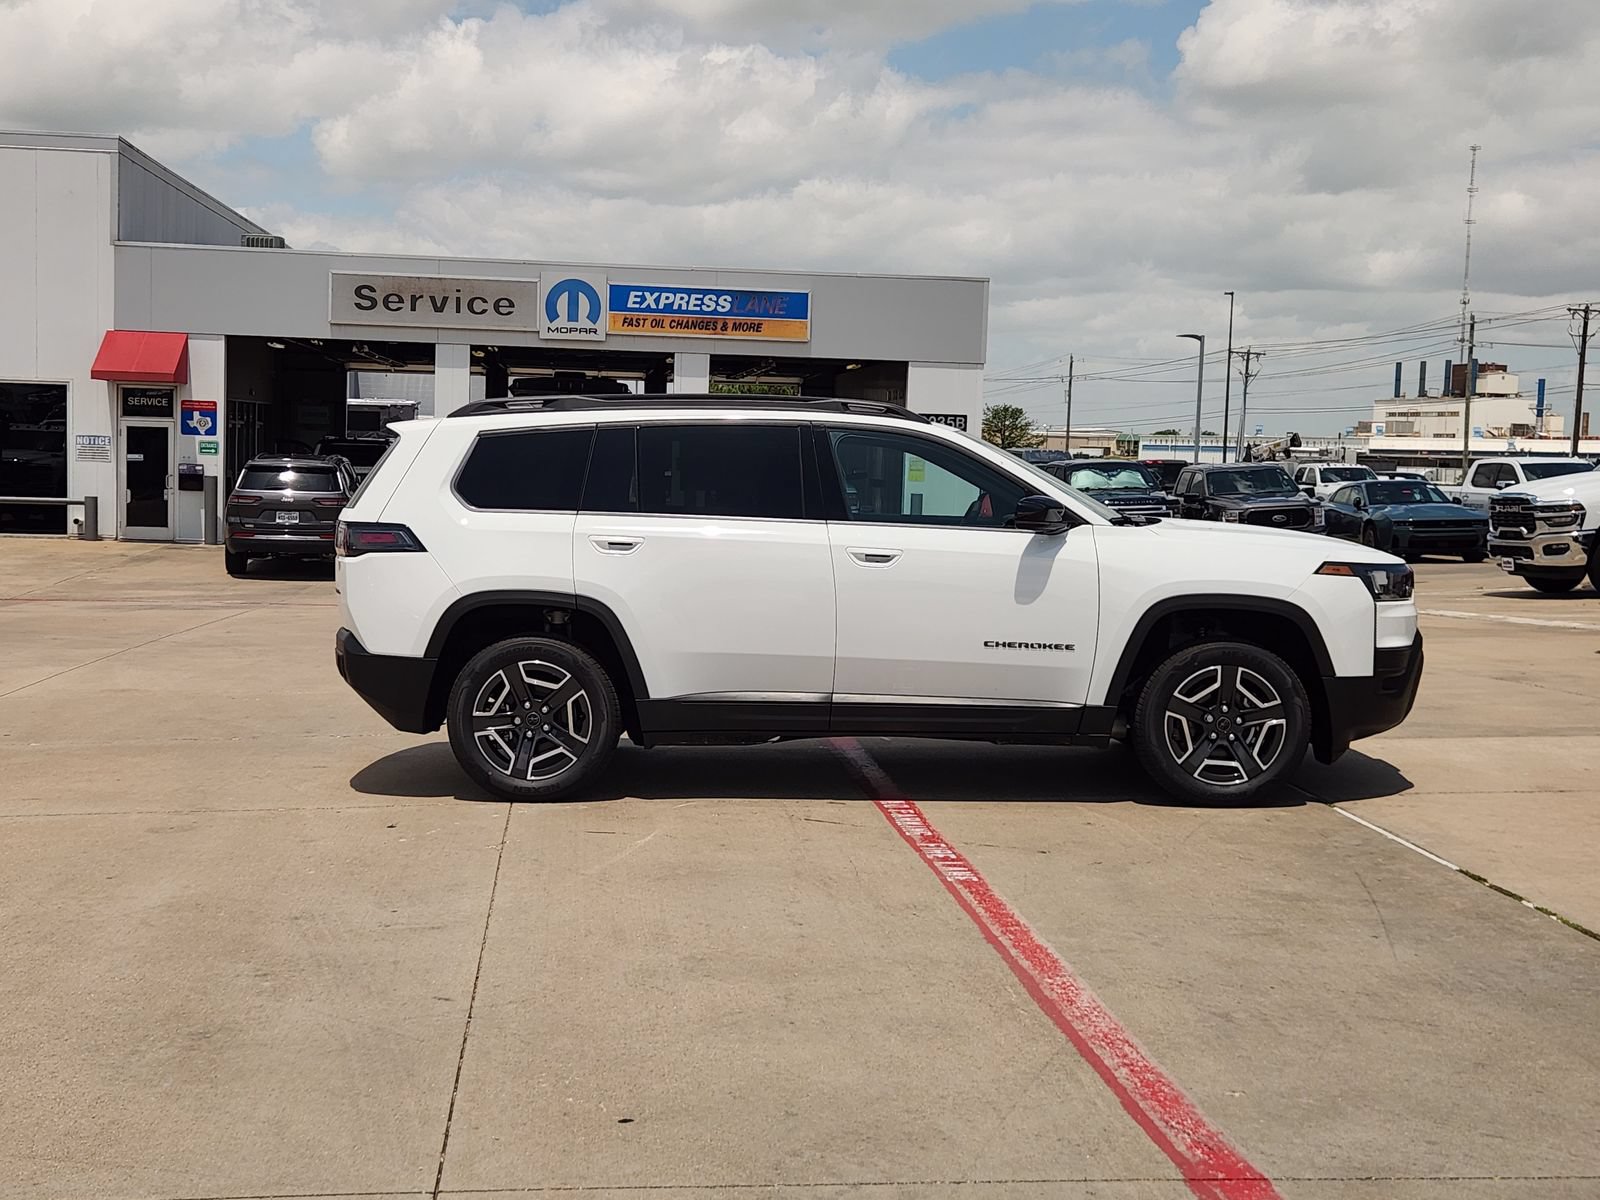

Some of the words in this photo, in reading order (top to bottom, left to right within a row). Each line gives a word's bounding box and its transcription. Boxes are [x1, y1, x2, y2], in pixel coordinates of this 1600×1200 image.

[353, 284, 516, 316] Service
[547, 325, 598, 336] MOPAR
[621, 316, 648, 329] FAST
[650, 317, 666, 329] OIL
[669, 319, 718, 332] CHANGES
[720, 321, 730, 333] &
[731, 322, 764, 334] MORE
[127, 396, 169, 407] SERVICE
[76, 435, 111, 446] NOTICE
[983, 640, 1076, 651] CHEROKEE
